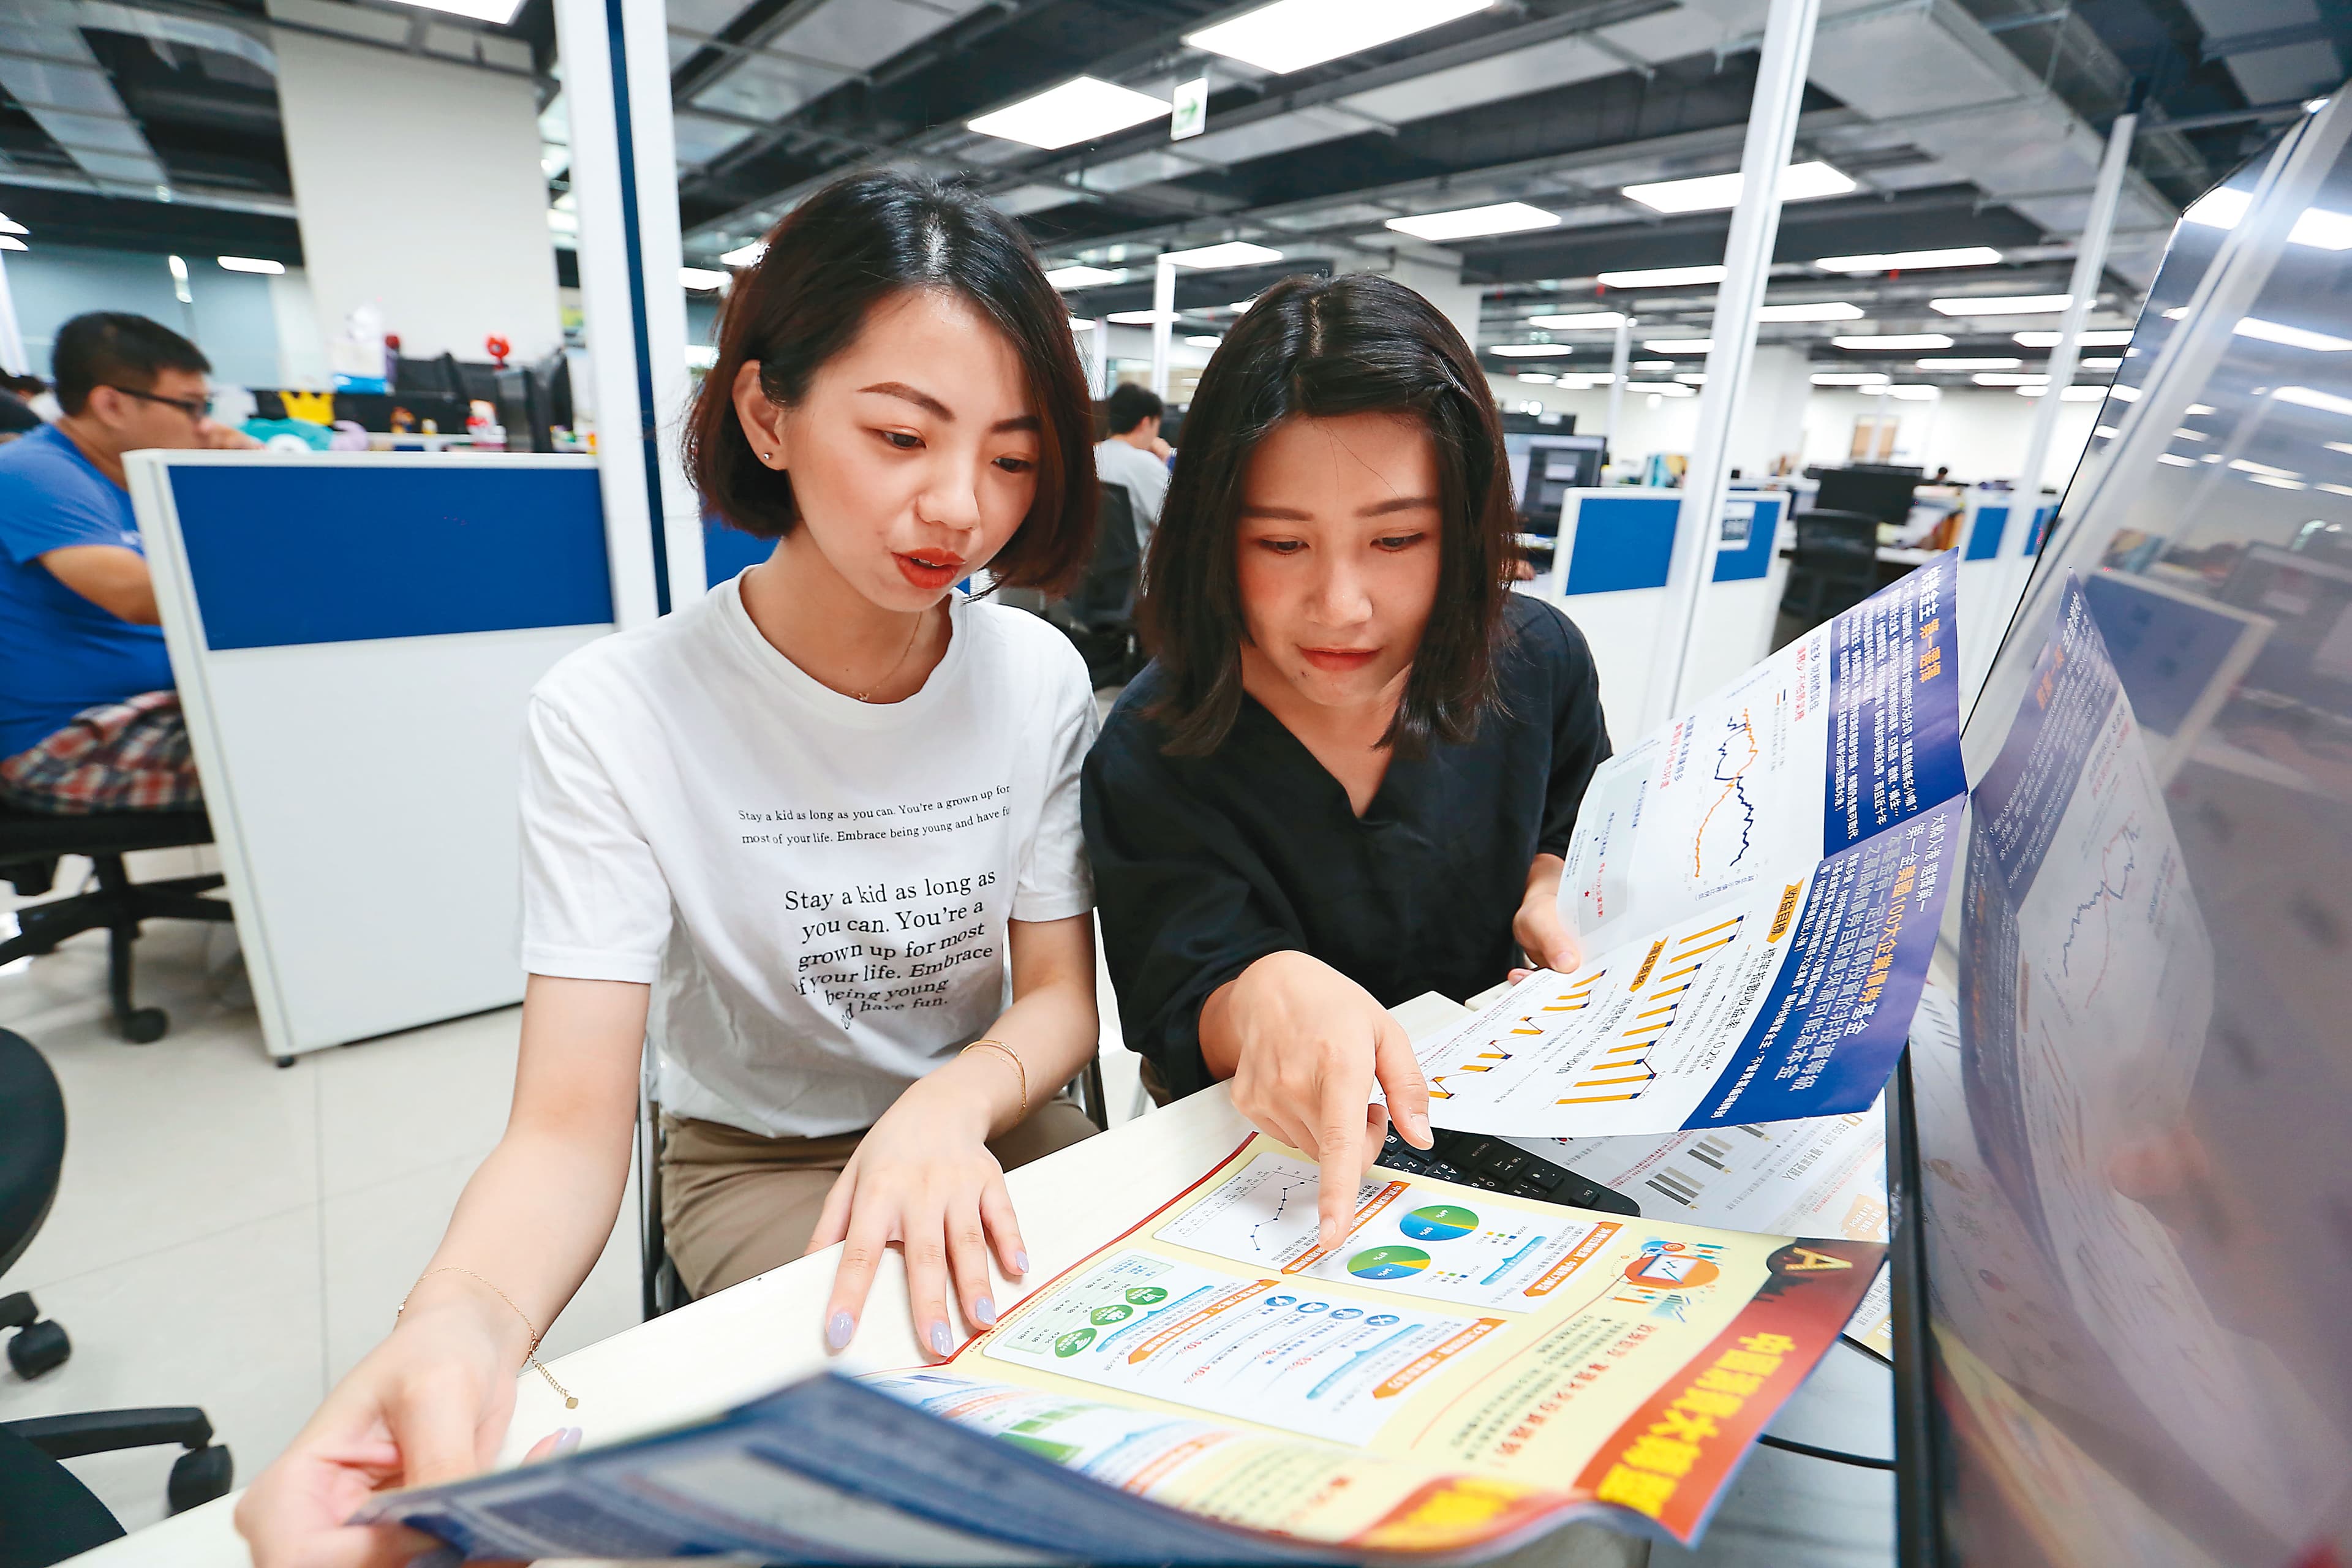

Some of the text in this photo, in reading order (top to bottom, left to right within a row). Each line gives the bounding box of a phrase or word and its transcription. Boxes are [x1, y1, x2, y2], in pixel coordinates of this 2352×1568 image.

[1918, 562, 1942, 686] 快樂金主 第一選擇
[739, 810, 761, 823] Stay
[775, 809, 793, 820] kid
[810, 809, 833, 820] long
[853, 809, 873, 820] you
[876, 807, 895, 816] can.
[899, 802, 933, 815] You're
[946, 794, 978, 809] grown
[981, 790, 993, 801] up
[997, 785, 1009, 794] for
[742, 834, 769, 843] most
[772, 834, 783, 844] of
[786, 833, 810, 845] your
[813, 832, 832, 842] life.
[837, 829, 886, 842] Embrace
[890, 826, 919, 839] being
[922, 821, 952, 835] young
[955, 816, 973, 829] and
[976, 811, 1000, 823] have
[1913, 812, 1943, 914] 大船入港 選擇第一
[785, 870, 995, 911] Stay a kid as long as
[1771, 887, 1800, 937] 收益目標
[802, 900, 983, 943] you can. You're a
[1841, 819, 1927, 1038] 第一金美國100大企業債券基金
[798, 923, 984, 972] grown up for most
[810, 971, 858, 993] your
[864, 965, 901, 982] life.
[908, 946, 993, 978] Embrace
[1773, 840, 1885, 1081] 之高風險債券且配息來源可能為本金
[1788, 830, 1907, 1092] 本基金有一定比重得投資於非投資等級
[826, 978, 949, 1006] being young
[859, 1000, 905, 1013] have
[913, 997, 947, 1009] fun.
